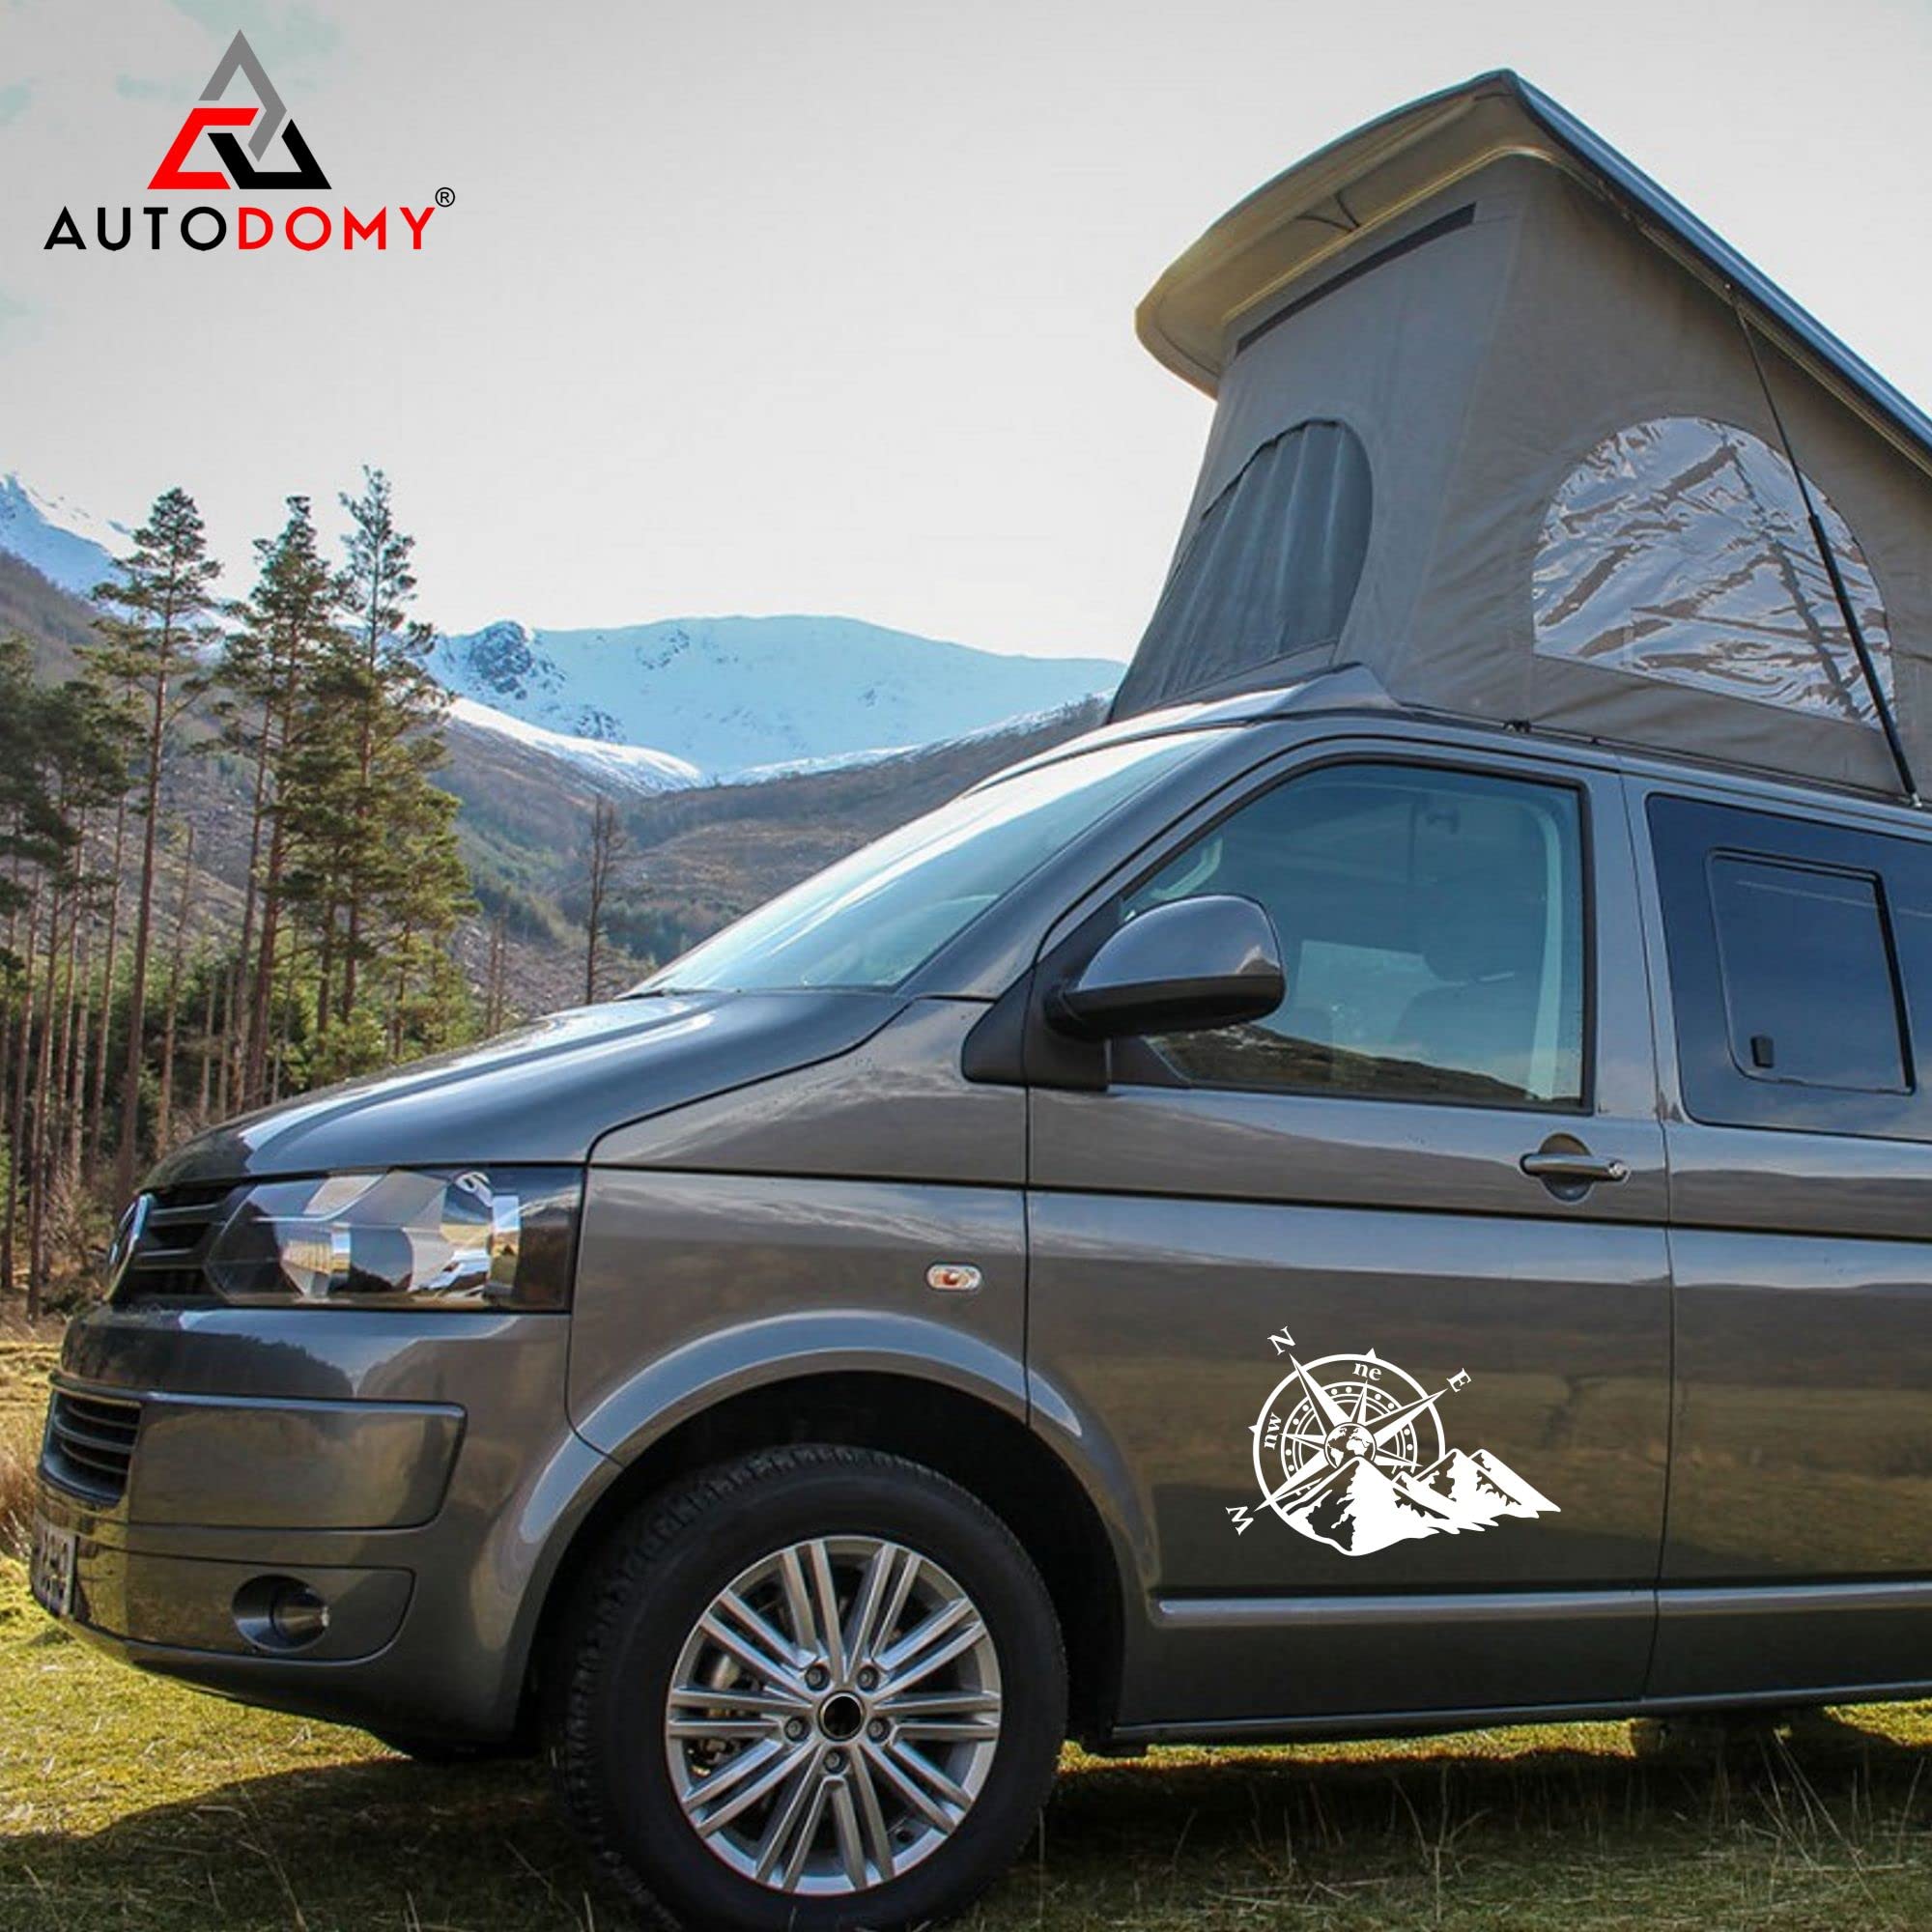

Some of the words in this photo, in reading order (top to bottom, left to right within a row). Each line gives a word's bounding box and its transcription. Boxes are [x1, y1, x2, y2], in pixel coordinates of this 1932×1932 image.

[1266, 1325, 1296, 1355] N
[1352, 1362, 1382, 1381] ne
[1445, 1367, 1472, 1393] E
[1264, 1410, 1282, 1451] nw
